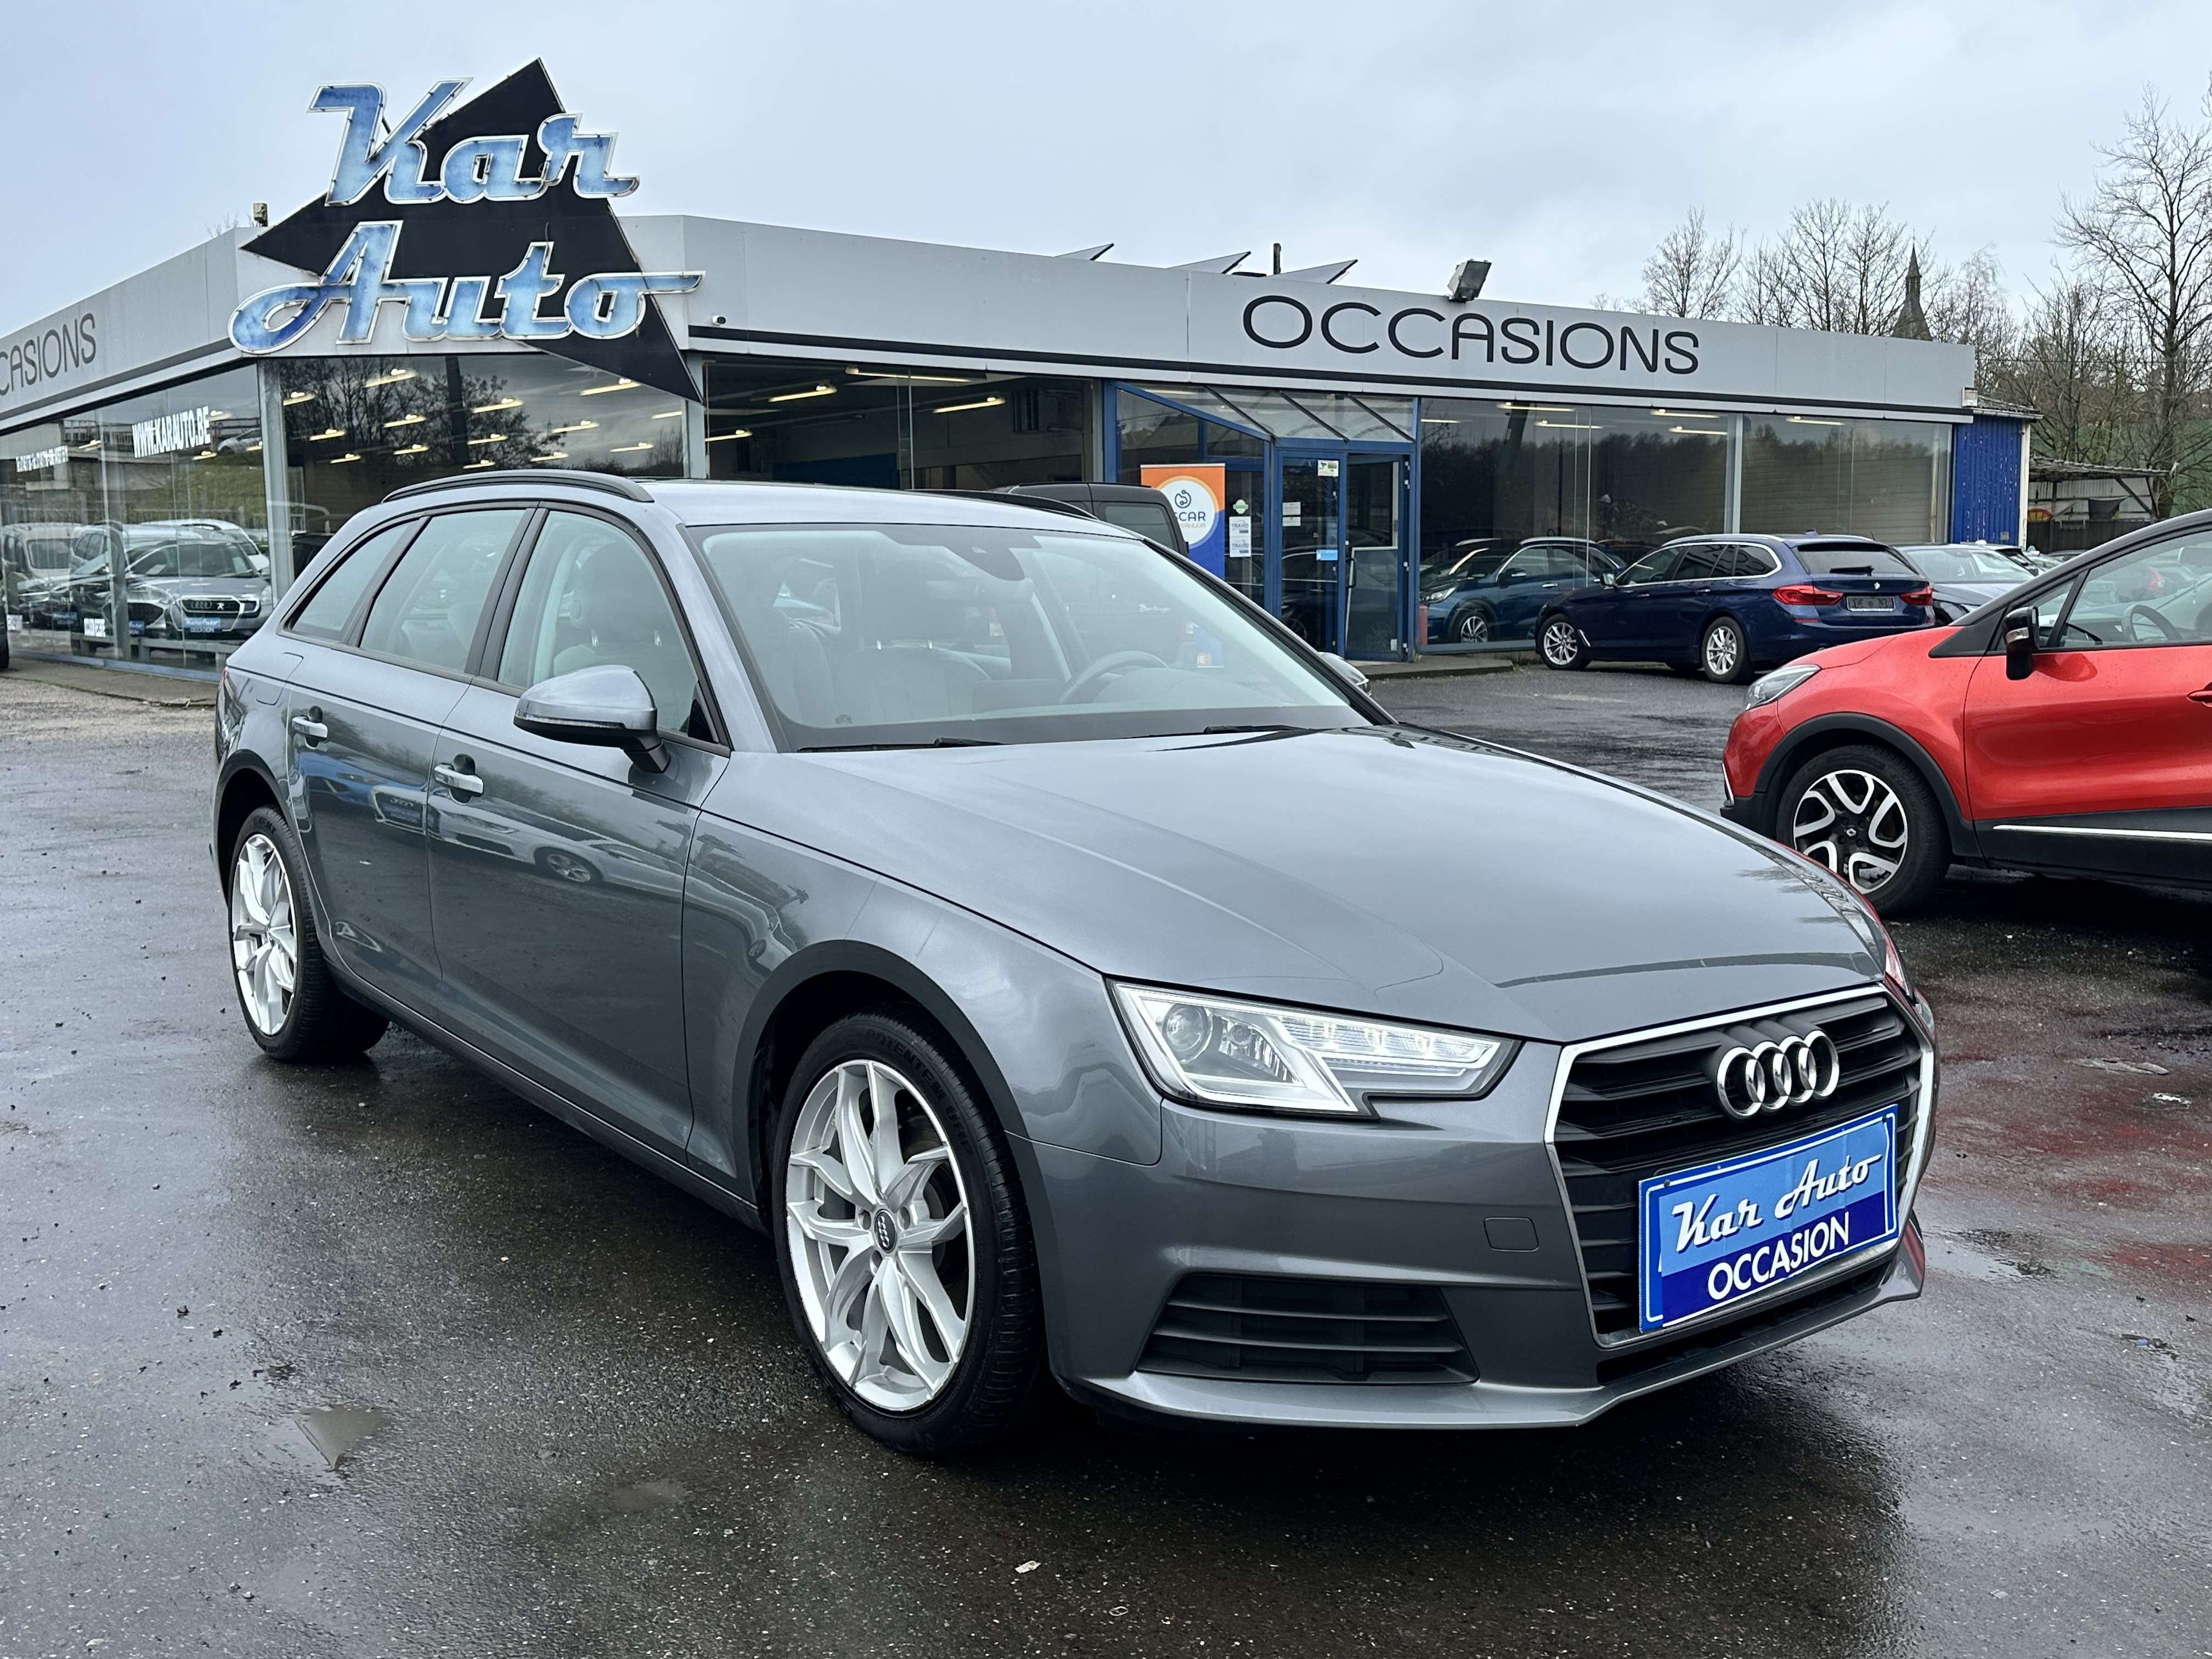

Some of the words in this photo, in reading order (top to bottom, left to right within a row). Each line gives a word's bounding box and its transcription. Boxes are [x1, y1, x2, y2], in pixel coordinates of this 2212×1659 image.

[306, 77, 640, 207] Kar
[228, 220, 707, 355] Auto
[1243, 295, 1699, 374] OCCASIONS
[132, 406, 211, 458] WWW.KARAUTO.BE
[1671, 1193, 1763, 1253] Kar
[1774, 1154, 1883, 1220] Auto
[1707, 1211, 1850, 1301] OCCASION
